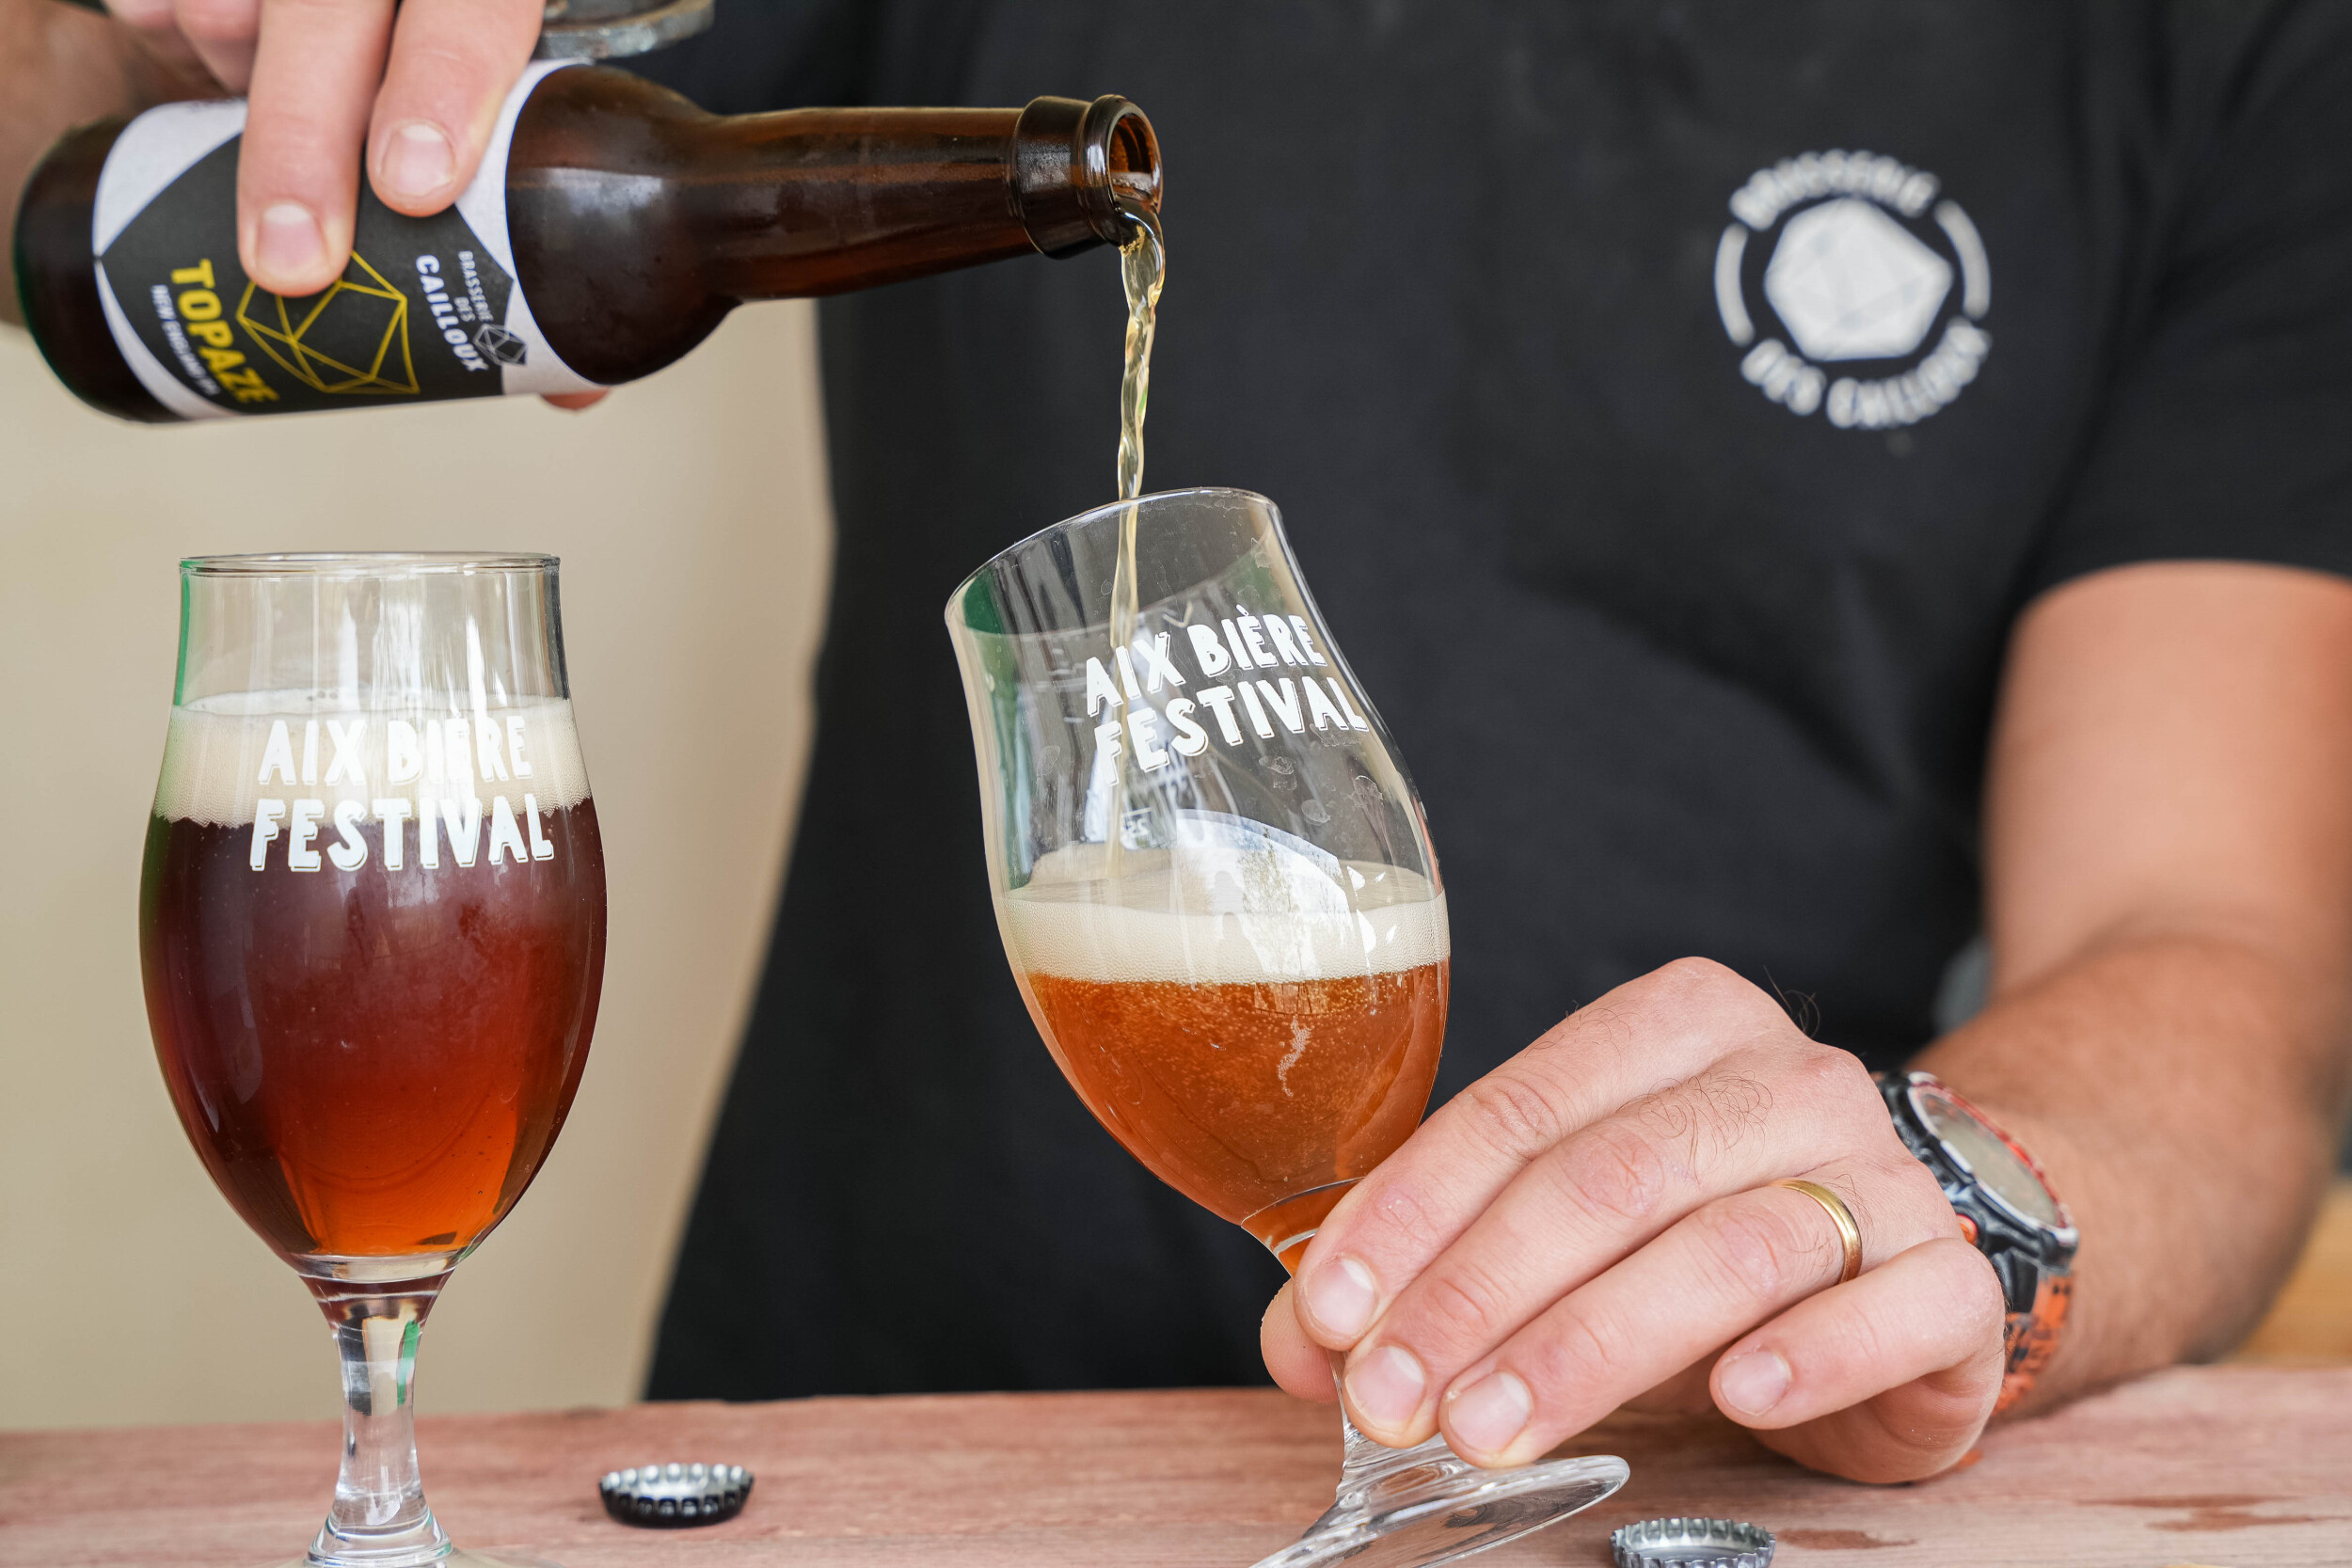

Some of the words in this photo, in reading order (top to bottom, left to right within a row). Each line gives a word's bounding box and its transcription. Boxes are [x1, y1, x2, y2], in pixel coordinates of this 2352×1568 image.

[170, 258, 280, 404] TOPAZE
[416, 254, 490, 372] CAILLOUX
[453, 296, 476, 322] DES
[458, 250, 494, 322] BRASSERIE
[1085, 630, 1186, 718] AIX
[1186, 603, 1327, 678] BIÈRE
[257, 719, 368, 786] AIX
[1093, 675, 1370, 786] FESTIVAL
[248, 793, 554, 872] FESTIVAL
